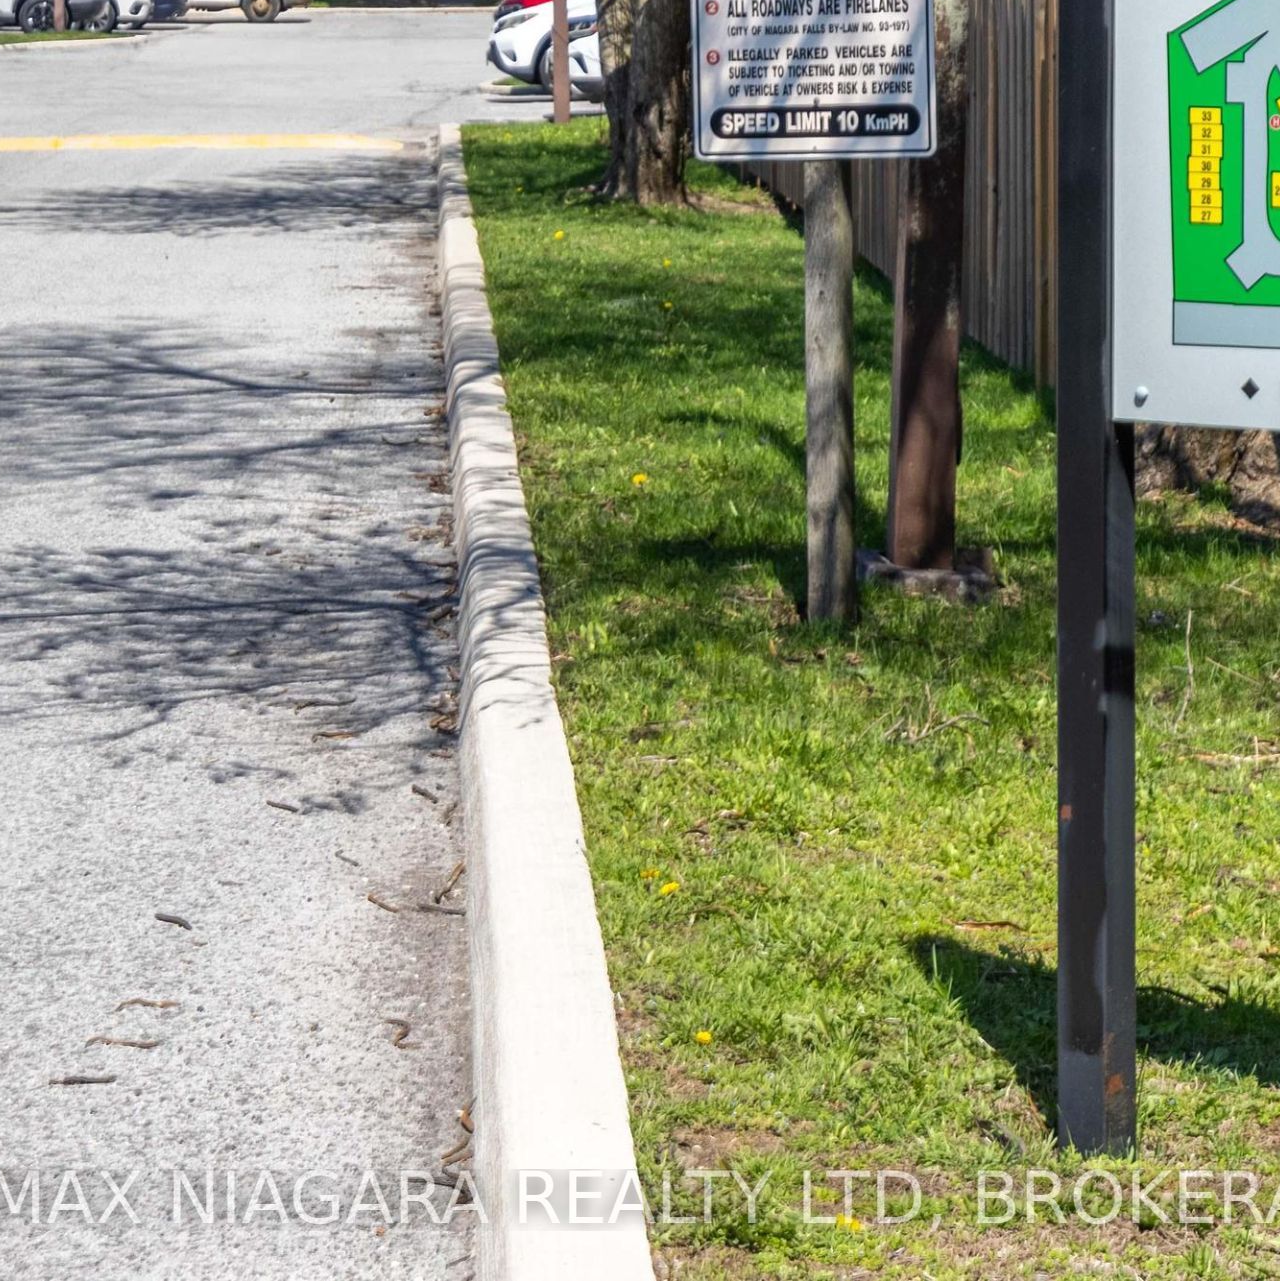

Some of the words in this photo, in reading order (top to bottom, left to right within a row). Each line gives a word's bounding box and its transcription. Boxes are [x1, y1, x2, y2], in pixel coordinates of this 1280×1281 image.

[707, 3, 716, 13] 2
[727, 25, 748, 38] (CITY
[751, 25, 762, 36] OF
[765, 24, 799, 36] NIAGARA
[802, 23, 825, 34] FALLS
[828, 22, 859, 34] BY-LAW
[862, 21, 876, 32] NO.
[879, 20, 910, 33] 93-197)
[709, 52, 717, 63] 3
[728, 47, 780, 62] ILLEGALLY
[786, 46, 829, 60] PARKED
[834, 45, 886, 59] VEHICLES
[891, 44, 913, 57] ARE
[729, 65, 769, 79] SUBJECT
[773, 65, 784, 78] TO
[787, 63, 835, 77] TICKETING
[880, 62, 915, 76] TOWING
[729, 85, 740, 98] OF
[743, 84, 780, 97] VEHICLE
[782, 83, 793, 96] AT
[796, 82, 834, 96] OWNERS
[837, 81, 858, 94] RISK
[861, 82, 867, 94] &
[872, 81, 913, 94] EXPENSE
[721, 112, 780, 135] SPEED
[785, 111, 832, 133] LIMIT
[836, 110, 859, 132] 10
[865, 113, 908, 131] KmPH
[1201, 111, 1212, 121] 33
[1201, 128, 1212, 138] 32
[1201, 144, 1212, 155] 31
[1201, 211, 1212, 221] 27
